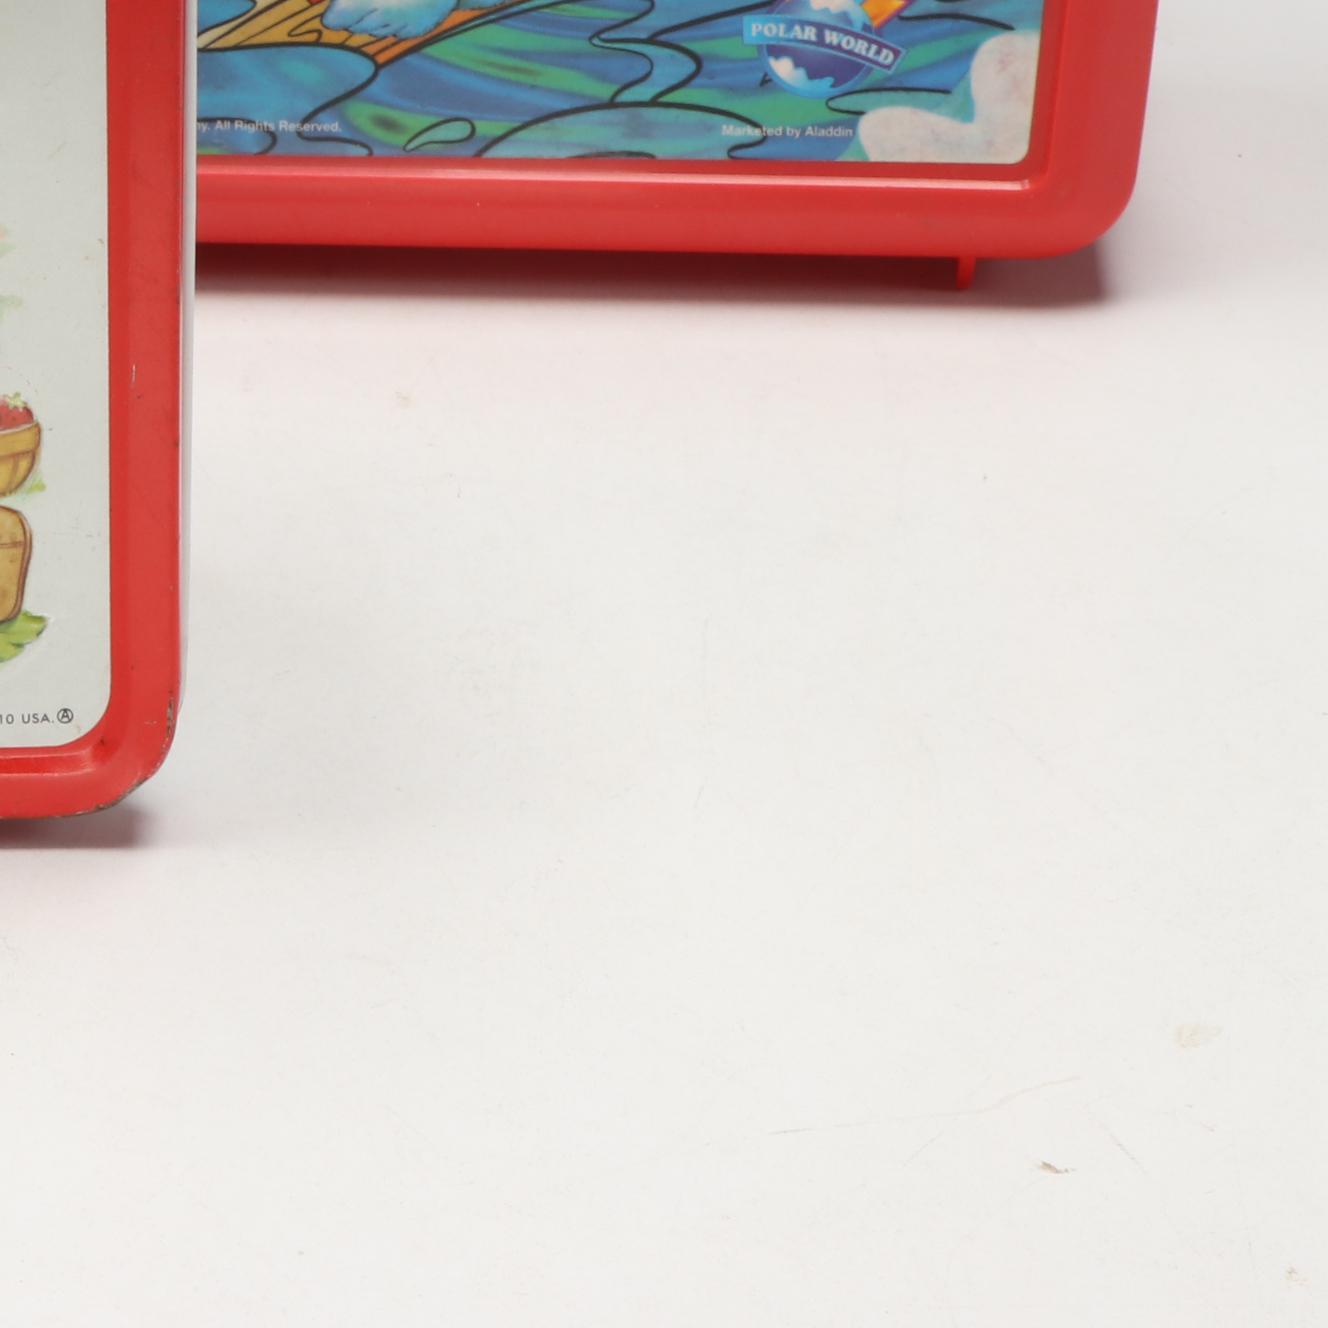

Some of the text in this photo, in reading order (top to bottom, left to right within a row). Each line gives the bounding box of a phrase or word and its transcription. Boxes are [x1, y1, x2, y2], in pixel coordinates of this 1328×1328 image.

[750, 22, 895, 67] POLAR WORLD
[215, 119, 231, 130] All
[234, 119, 274, 133] Rights
[278, 120, 343, 133] Reserved.
[722, 125, 853, 138] Marketed by Aladdin
[22, 713, 54, 724] USA.
